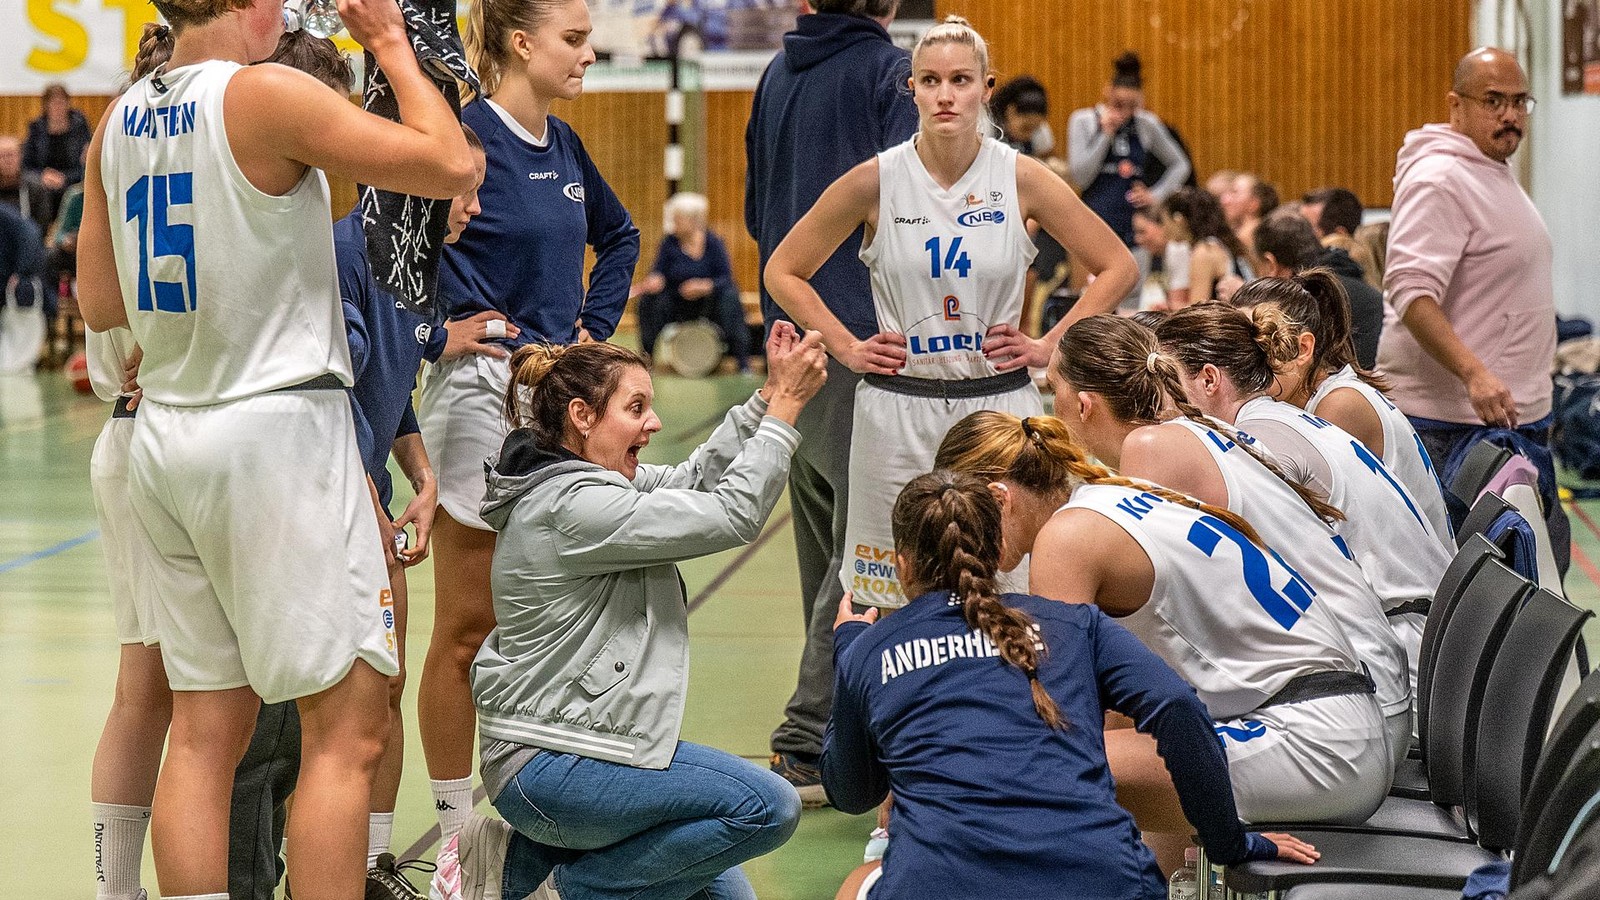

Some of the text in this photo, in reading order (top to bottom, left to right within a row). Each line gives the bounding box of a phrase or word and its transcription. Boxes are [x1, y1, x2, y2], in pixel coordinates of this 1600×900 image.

[529, 171, 553, 180] CRAFT
[894, 217, 922, 225] CRAFT
[126, 172, 197, 312] 15
[925, 236, 972, 278] 14
